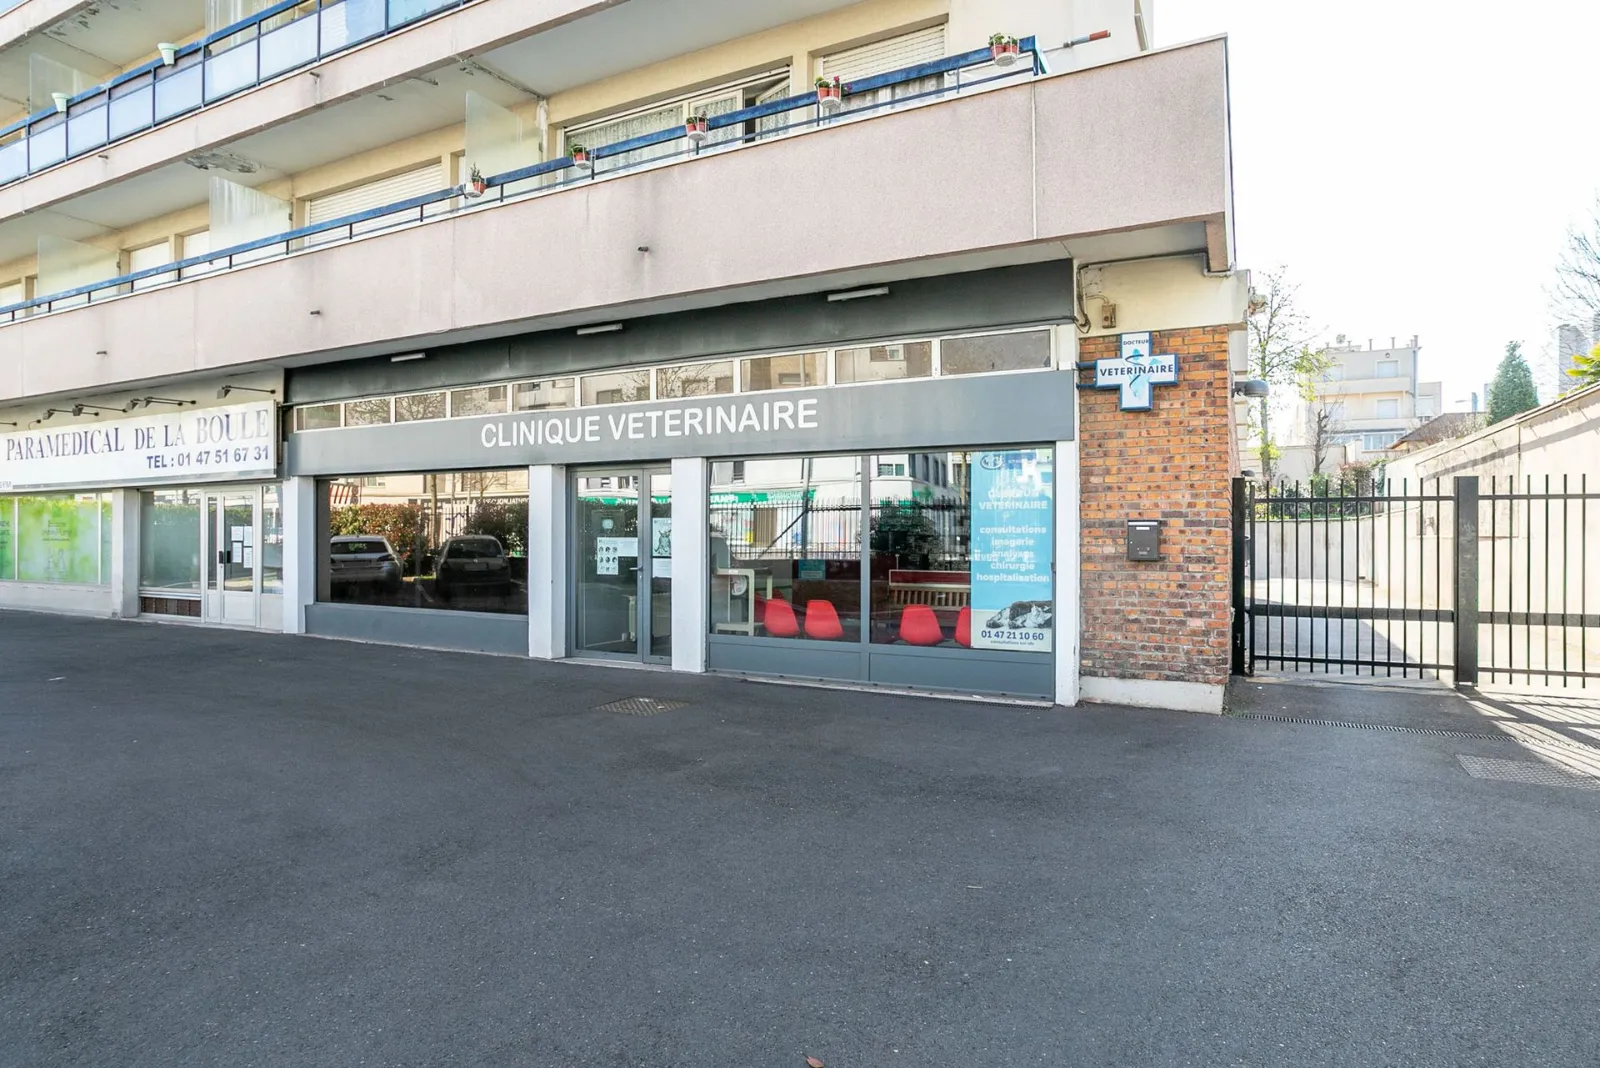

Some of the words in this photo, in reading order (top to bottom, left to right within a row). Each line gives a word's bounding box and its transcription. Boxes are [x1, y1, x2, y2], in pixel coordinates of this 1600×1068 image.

[1100, 364, 1174, 377] VETERINAIRE
[481, 415, 601, 448] CLINIQUE
[608, 398, 819, 441] VETERINAIRE
[6, 426, 125, 461] PARAMEDICAL
[135, 426, 156, 450] DE
[164, 423, 186, 448] LA
[196, 408, 270, 445] BOULE
[177, 452, 191, 467] 01
[196, 450, 211, 465] 47
[215, 448, 229, 464] 51
[234, 447, 250, 462] 67
[254, 445, 269, 460] 31
[979, 500, 1048, 510] VETERINAIRE
[980, 525, 1047, 534] consultations
[991, 536, 1035, 548] imagerie
[990, 560, 1036, 572] chirurgie
[976, 572, 1050, 584] hospitalisation
[981, 630, 992, 638] 01
[994, 630, 1005, 639] 47
[1007, 631, 1017, 640] 21
[1020, 632, 1031, 640] 10
[1032, 632, 1045, 641] 60
